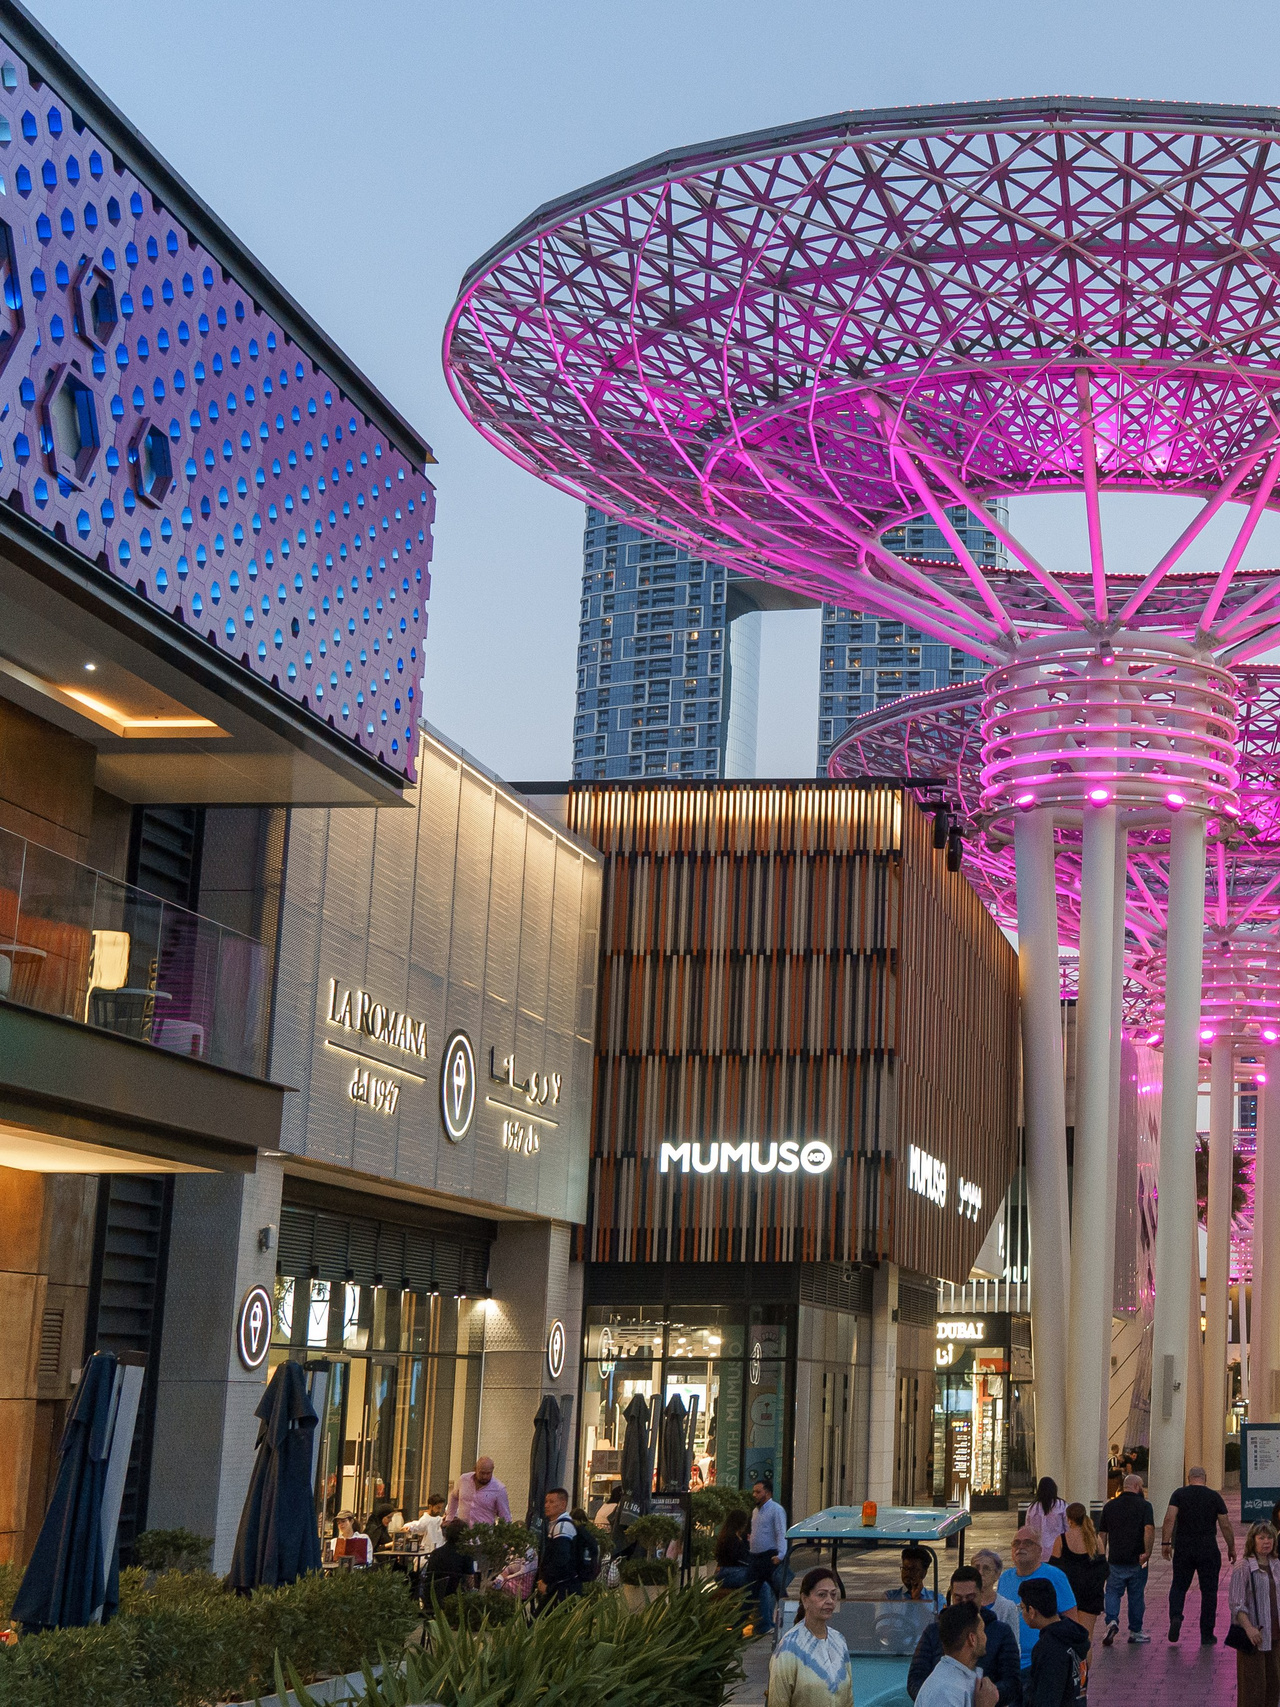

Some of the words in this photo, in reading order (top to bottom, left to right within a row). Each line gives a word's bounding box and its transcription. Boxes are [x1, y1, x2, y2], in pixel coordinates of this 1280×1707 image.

[328, 978, 354, 1030] LA
[356, 990, 428, 1058] ROMANA
[350, 1068, 370, 1103] dal
[372, 1078, 401, 1115] 1947
[660, 1141, 832, 1174] MUMUSO
[909, 1143, 947, 1208] MUMUSO
[936, 1322, 984, 1339] DUBAI
[726, 1341, 743, 1422] MUMUSO
